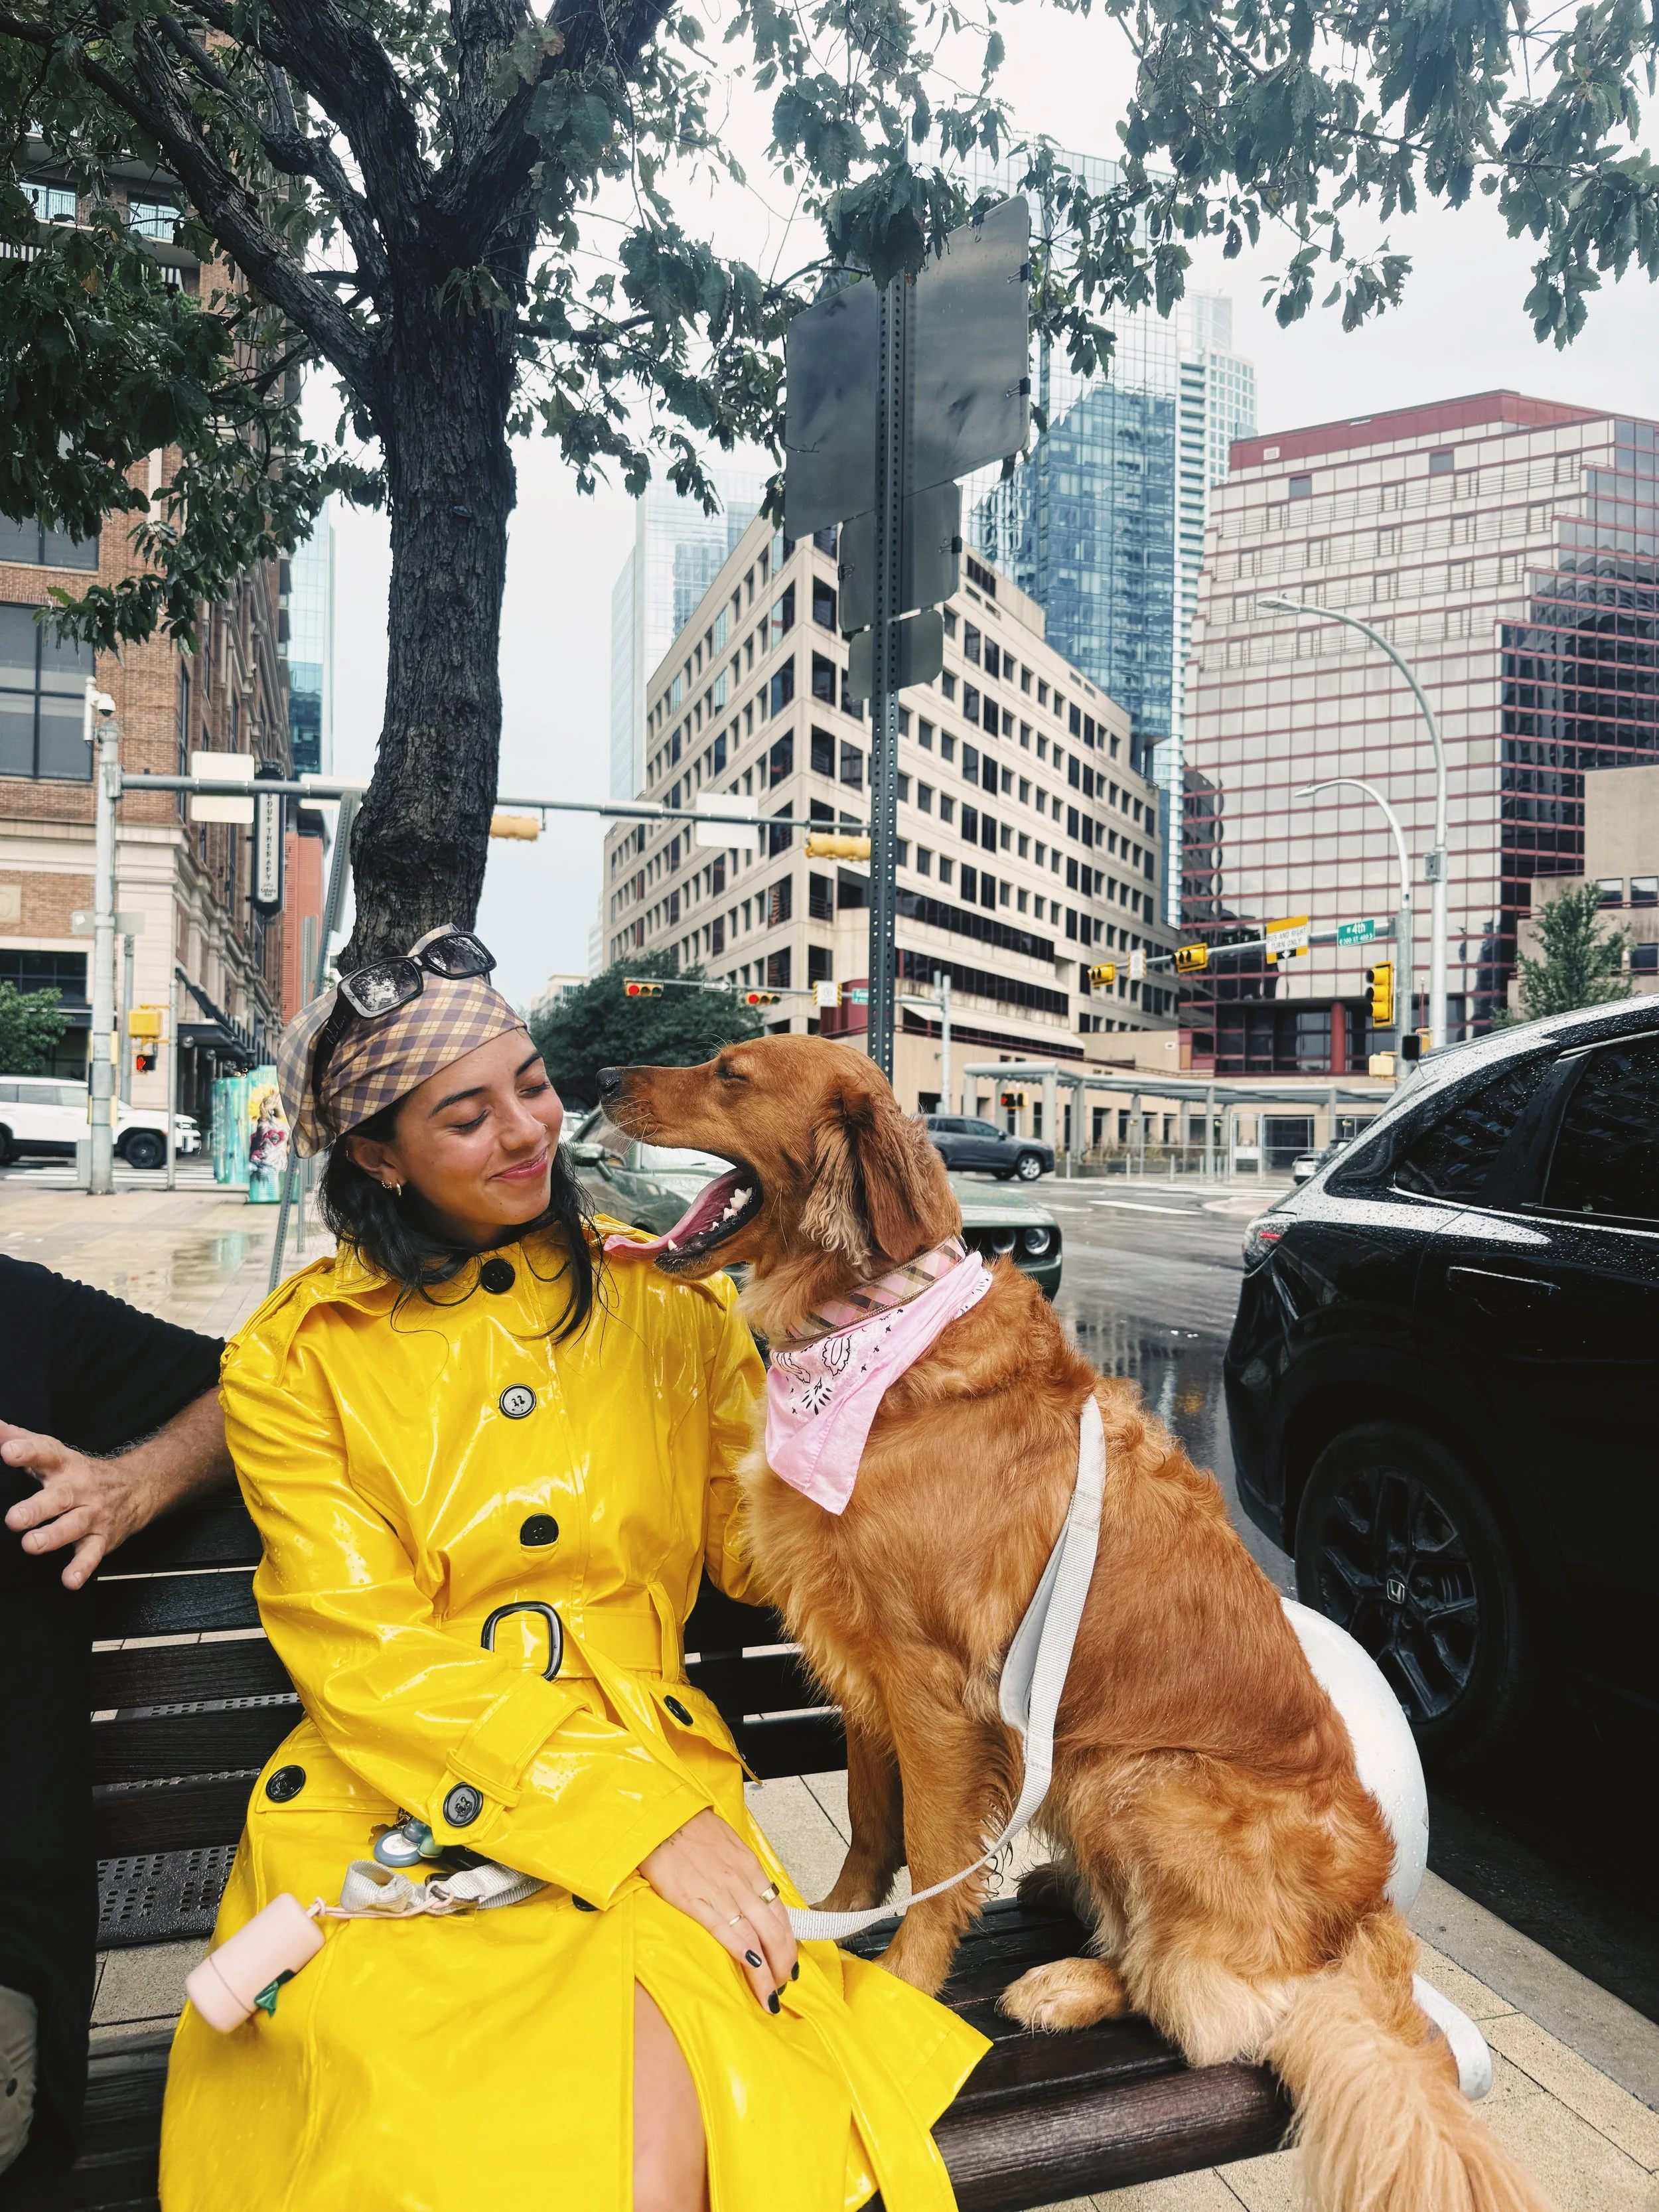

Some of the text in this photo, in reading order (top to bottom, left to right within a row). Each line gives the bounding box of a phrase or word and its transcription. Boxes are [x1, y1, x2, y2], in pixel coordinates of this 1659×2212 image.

[1291, 926, 1306, 936] RIGHT
[1352, 922, 1366, 934] 4th
[1287, 938, 1301, 946] ONLY
